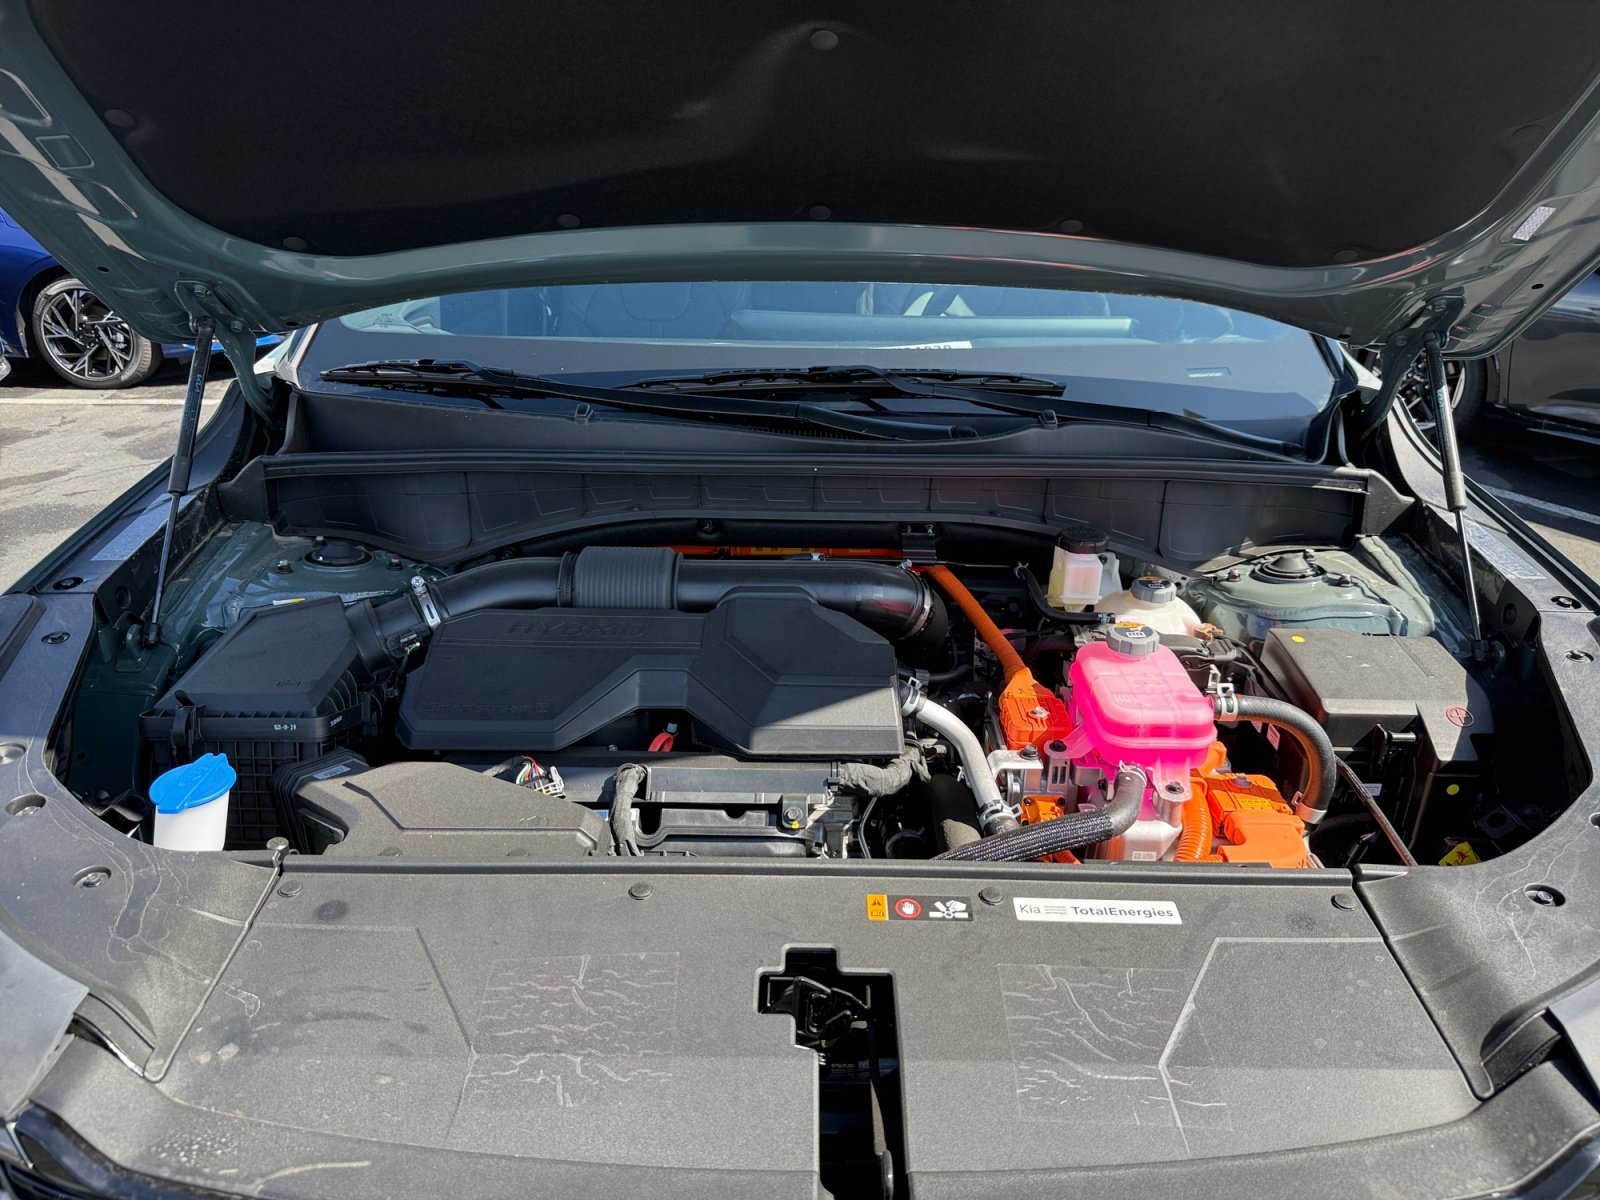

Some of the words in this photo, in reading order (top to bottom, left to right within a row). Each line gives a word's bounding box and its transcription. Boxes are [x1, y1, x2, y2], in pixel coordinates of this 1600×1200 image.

[507, 620, 648, 637] HYBRID
[1019, 904, 1041, 914] Kia
[1070, 906, 1174, 918] TotalEnergies
